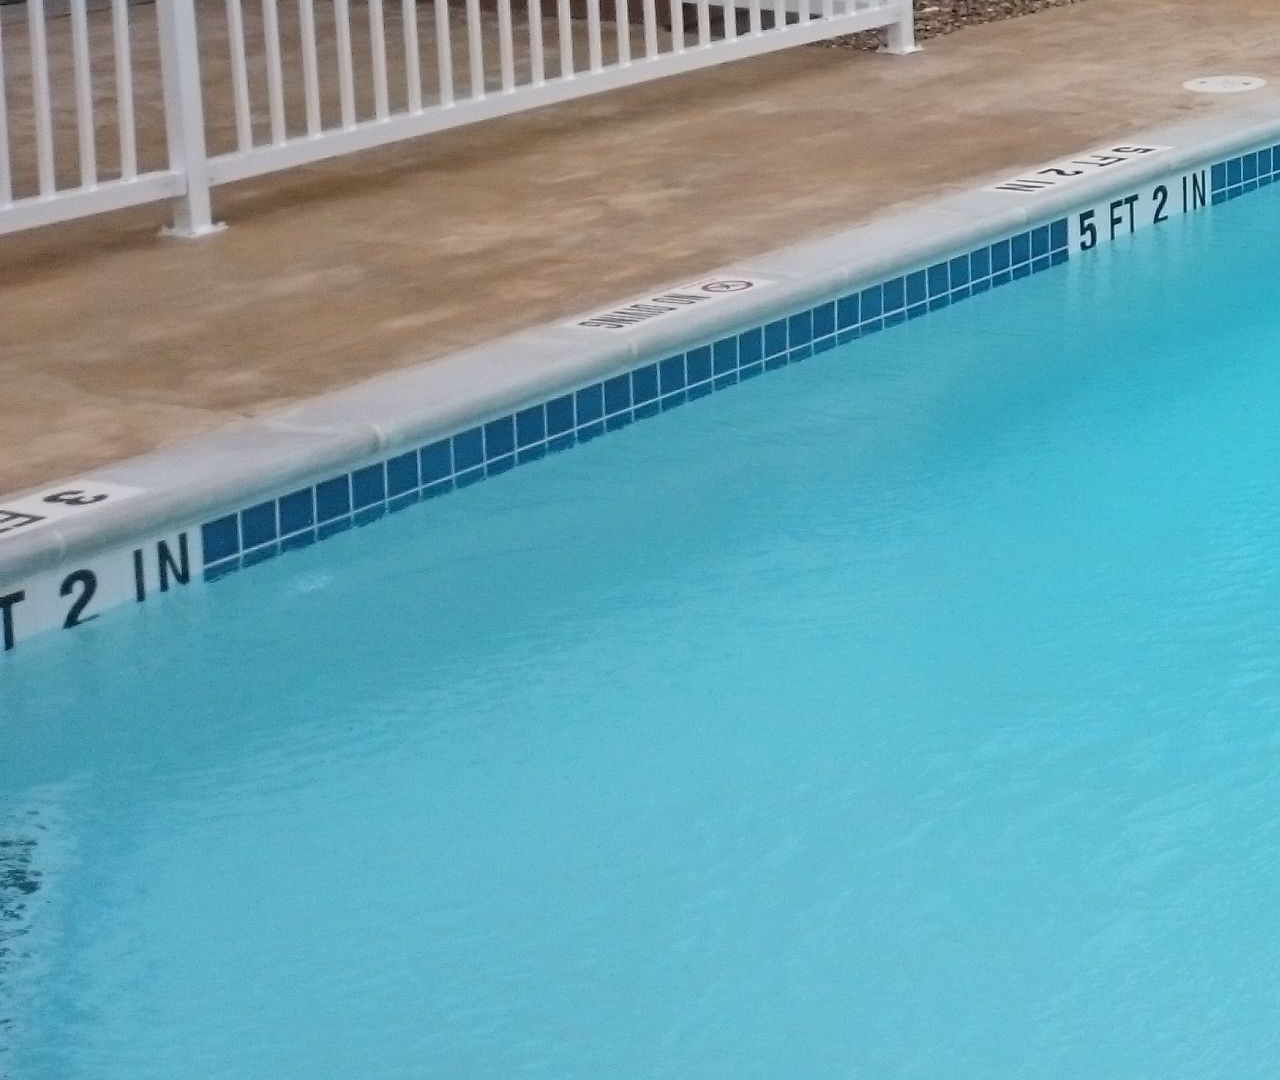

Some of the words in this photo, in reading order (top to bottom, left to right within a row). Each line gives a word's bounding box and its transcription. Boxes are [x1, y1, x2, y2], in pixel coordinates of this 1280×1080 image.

[1112, 146, 1156, 154] 5
[1072, 155, 1129, 167] FT
[1037, 167, 1084, 177] 2
[995, 179, 1056, 193] IN
[1079, 209, 1097, 251] 5
[1110, 194, 1139, 241] FT
[1152, 185, 1169, 225] 2
[1182, 170, 1206, 214] IN
[651, 293, 711, 305] NO
[576, 304, 679, 329] DIVING
[43, 490, 109, 506] 3
[60, 569, 100, 629] 2
[134, 532, 189, 602] IN
